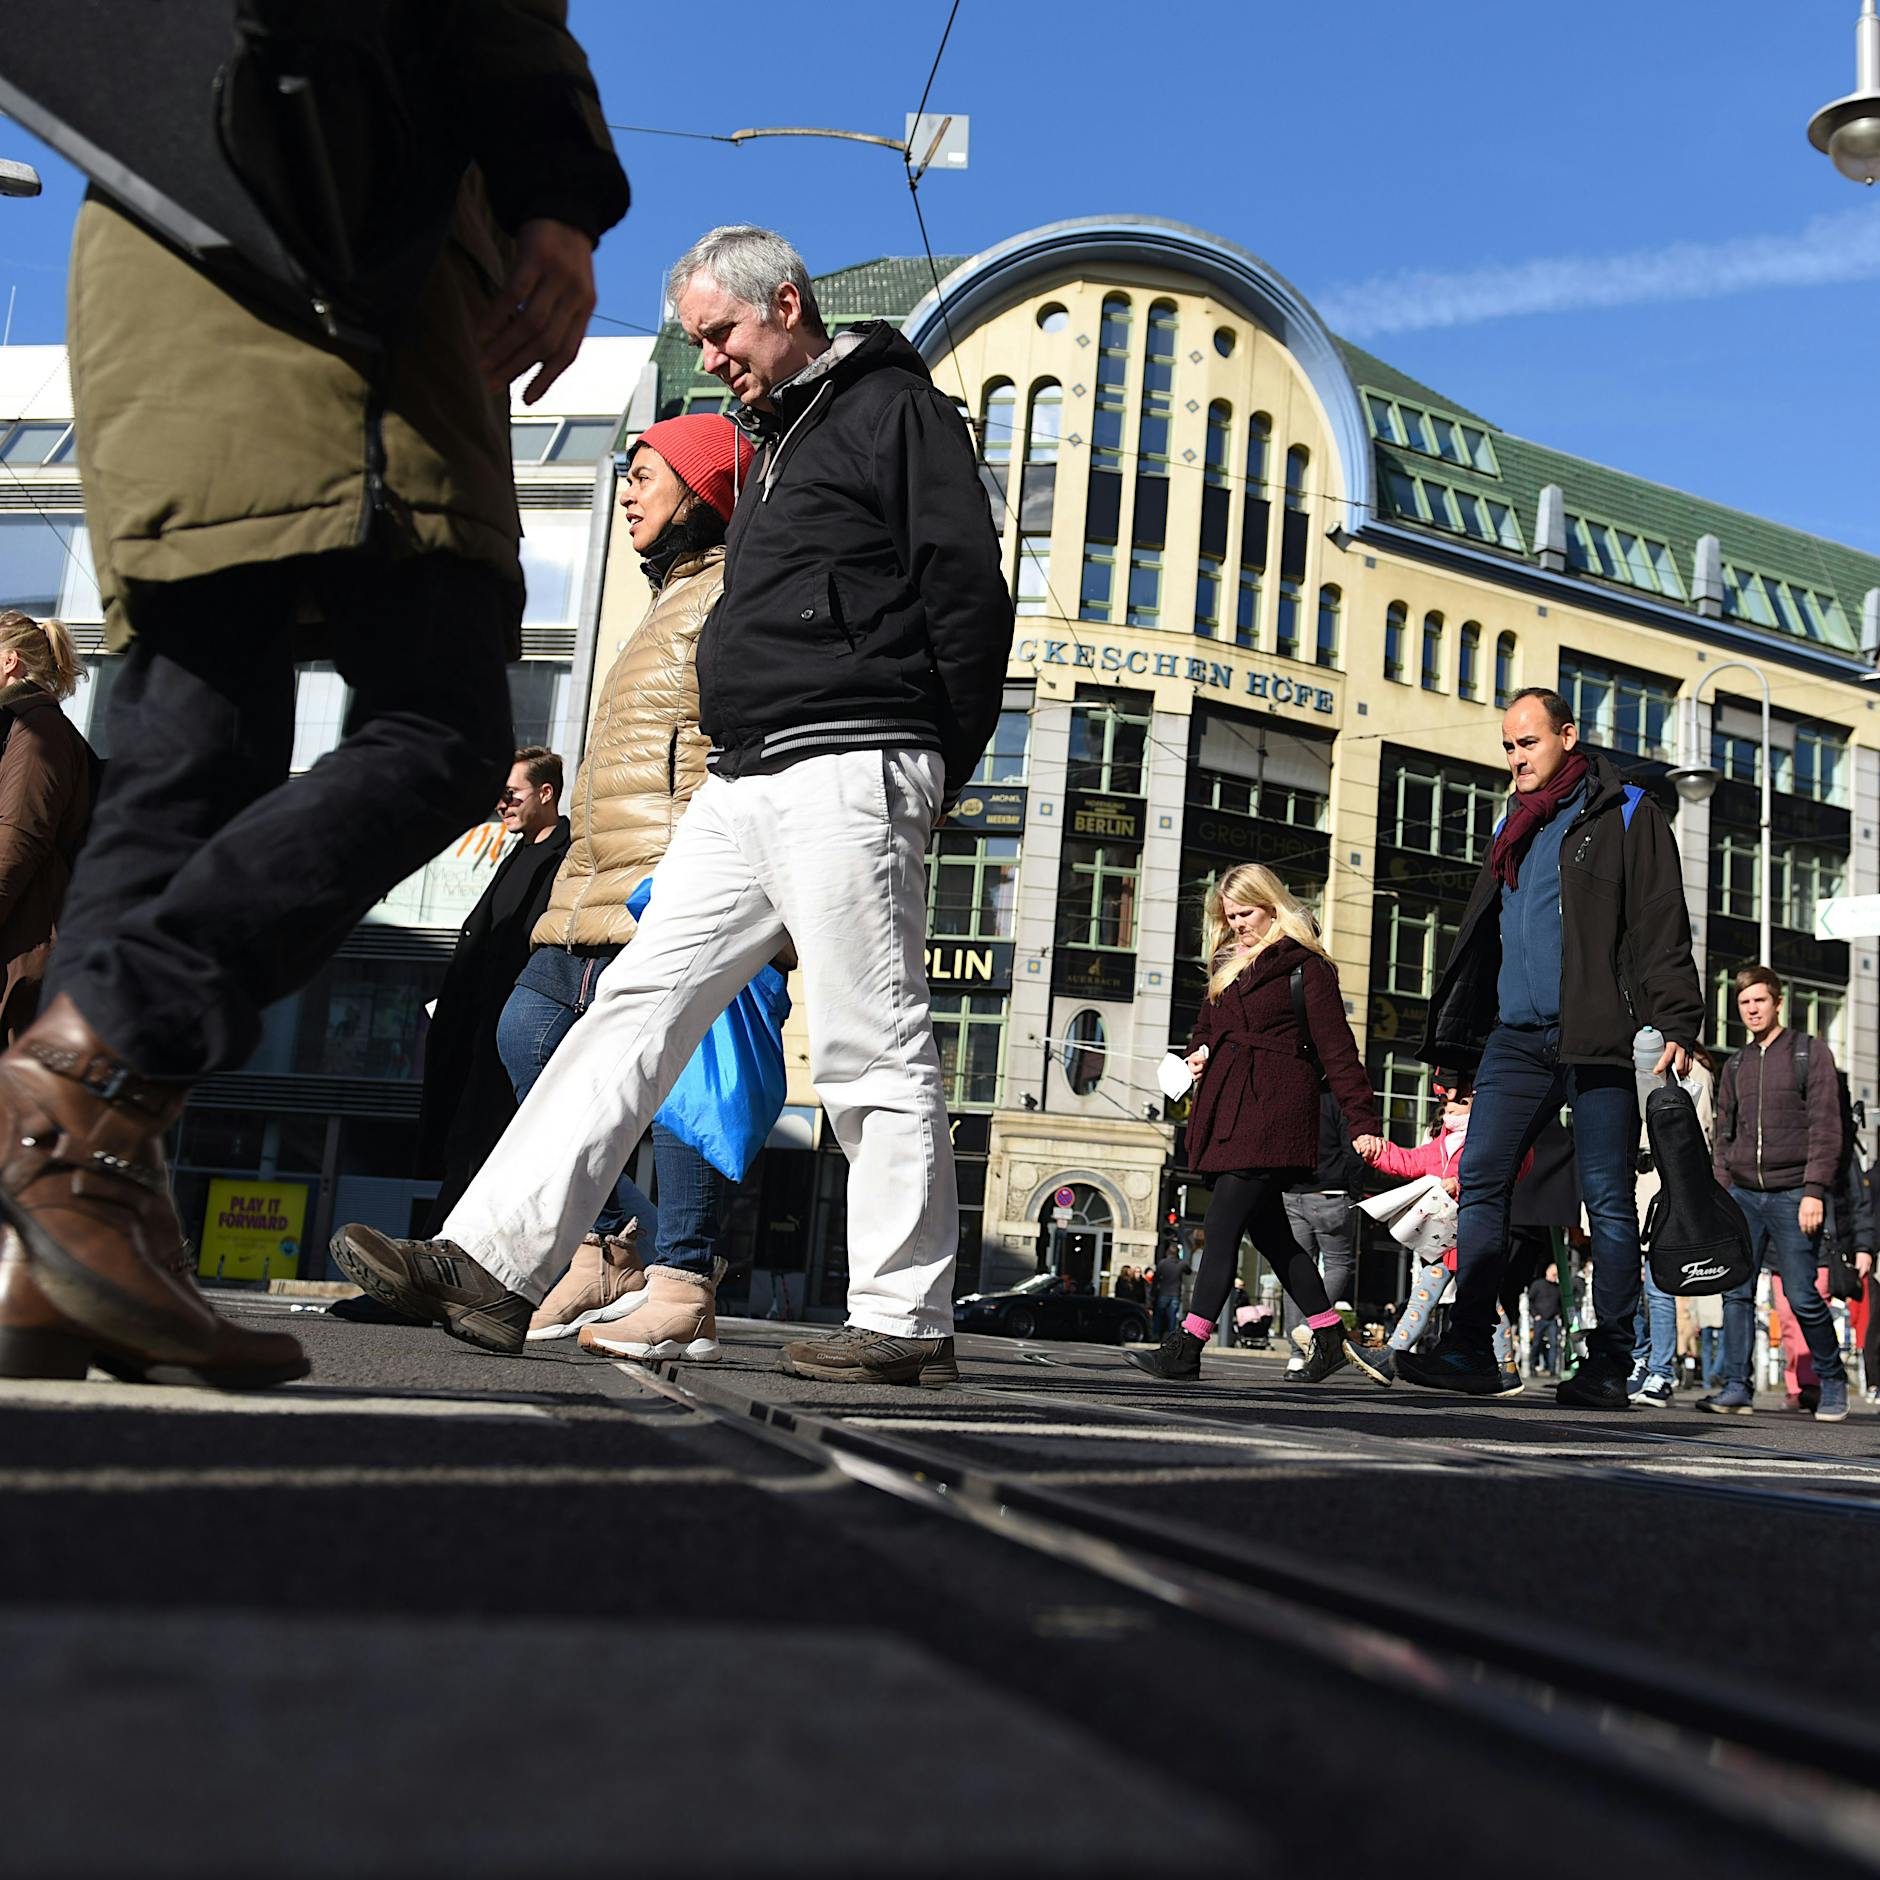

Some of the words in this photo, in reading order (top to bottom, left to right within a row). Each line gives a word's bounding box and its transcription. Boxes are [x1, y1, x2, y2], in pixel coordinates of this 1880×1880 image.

[1010, 639, 1233, 689] CKESCHEN
[1246, 671, 1334, 714] HÖFE
[1074, 815, 1135, 837] BERLIN
[231, 1196, 264, 1212] PLAY
[269, 1199, 281, 1214] IT
[219, 1212, 288, 1231] FORWARD
[1680, 1258, 1730, 1285] Fame
